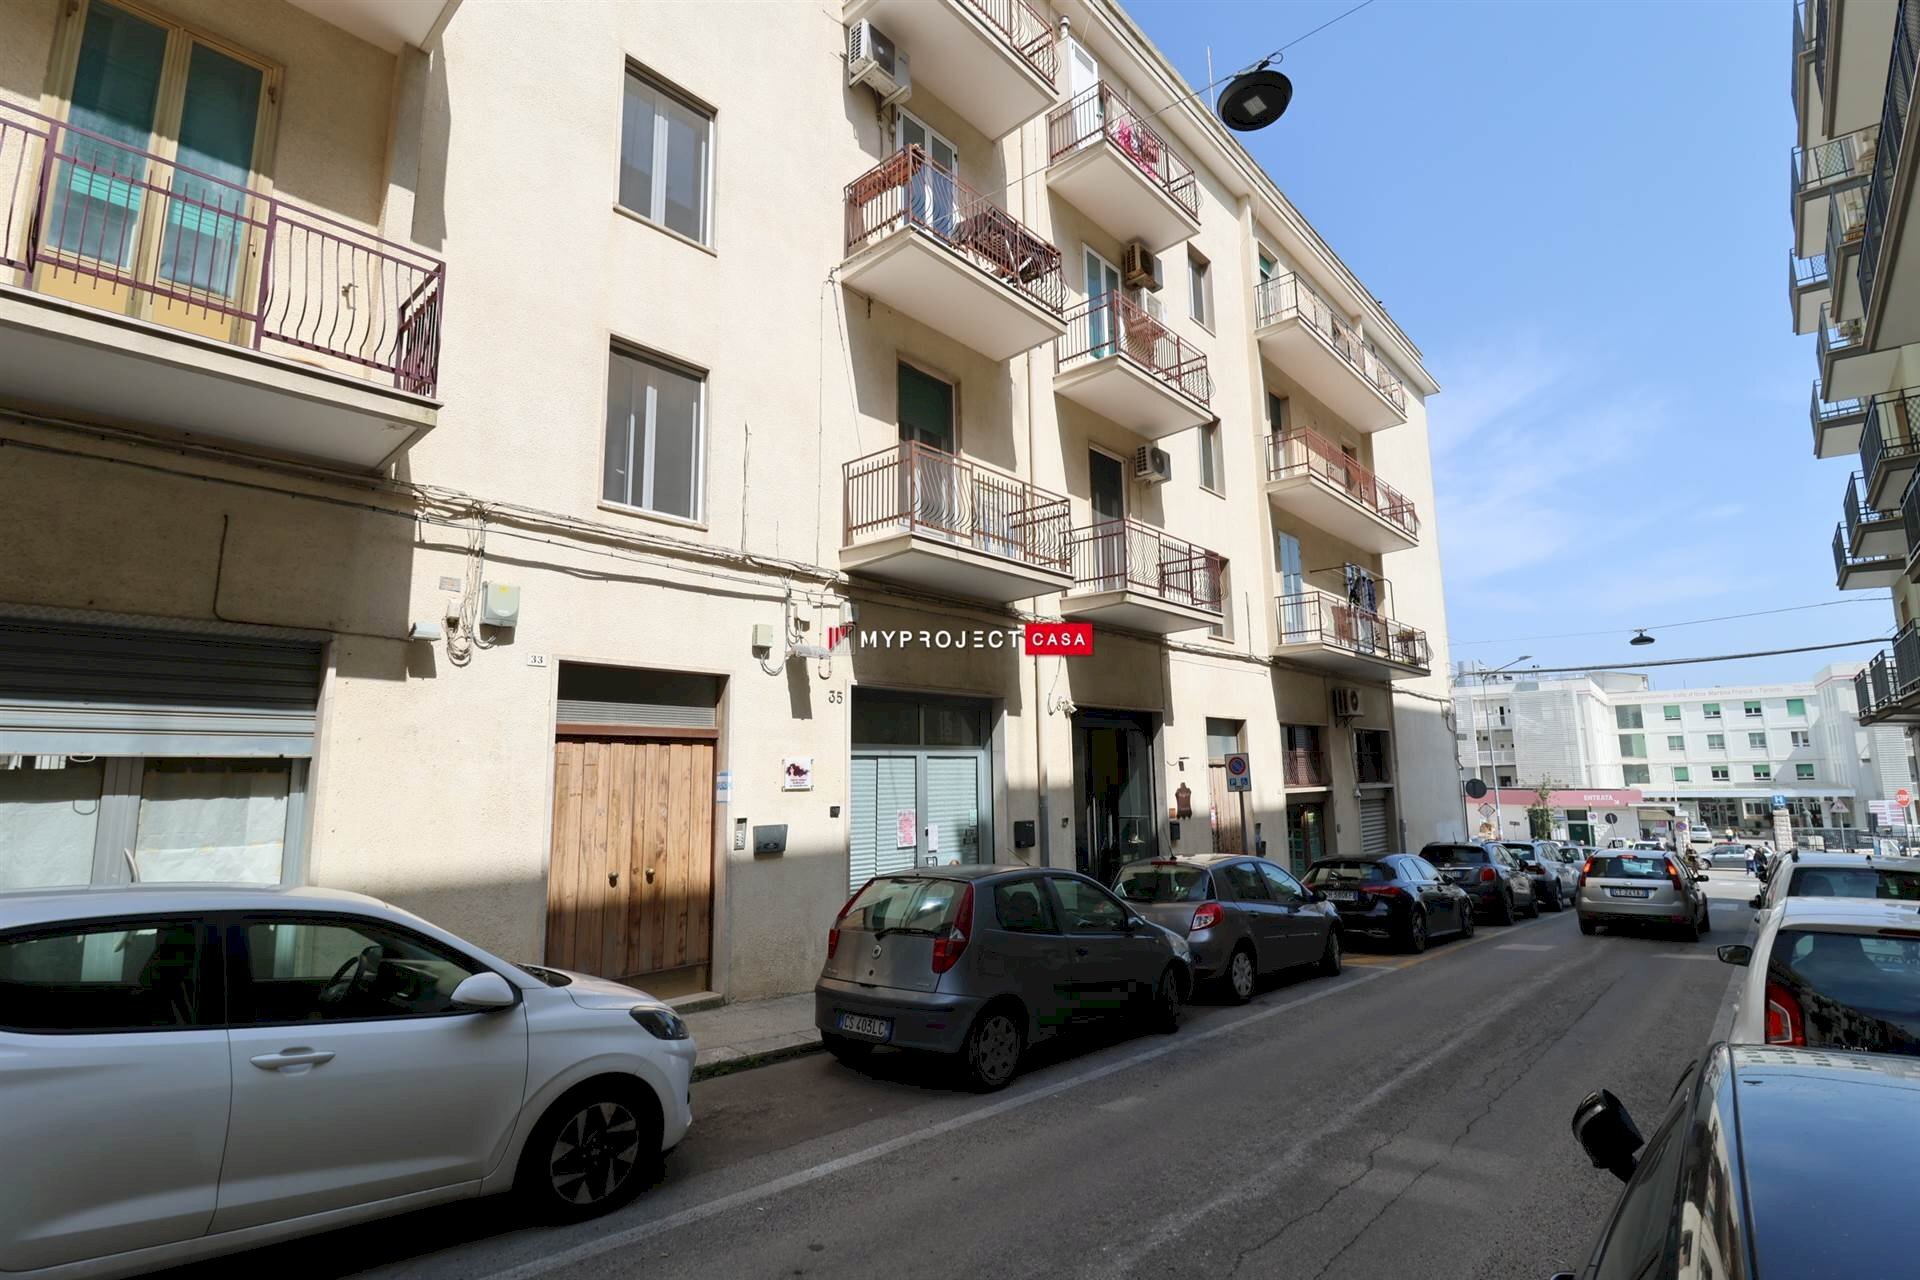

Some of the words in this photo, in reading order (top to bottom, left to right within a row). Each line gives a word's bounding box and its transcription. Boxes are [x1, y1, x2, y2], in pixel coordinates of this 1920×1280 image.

[531, 655, 543, 664] 33
[828, 690, 843, 705] 35
[1775, 795, 1783, 803] H
[844, 1014, 855, 1030] CS
